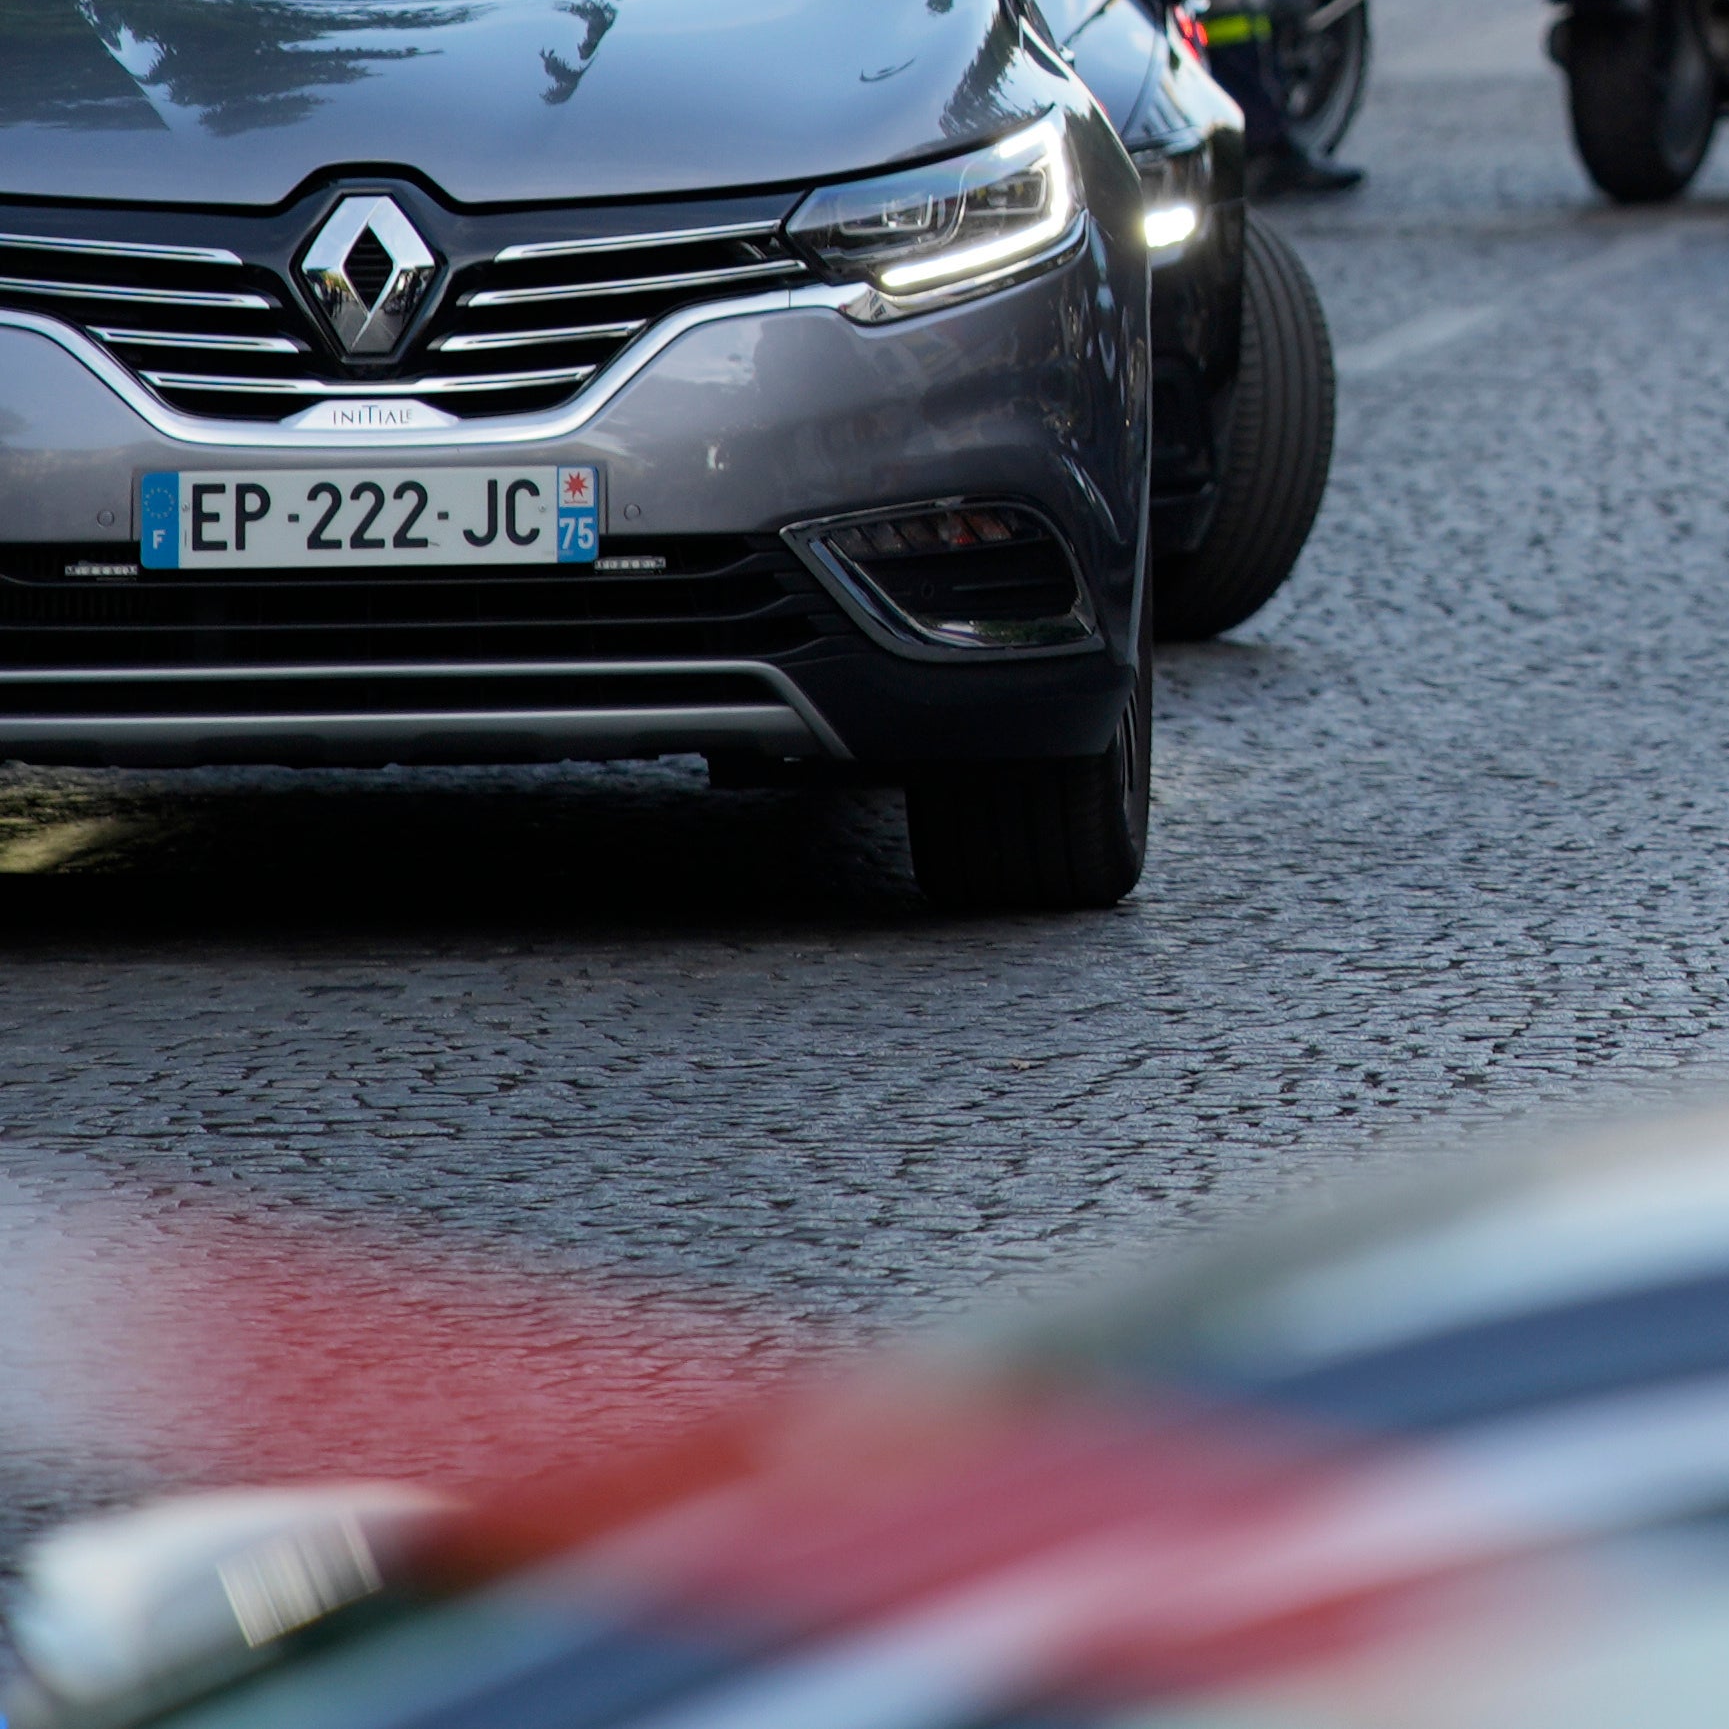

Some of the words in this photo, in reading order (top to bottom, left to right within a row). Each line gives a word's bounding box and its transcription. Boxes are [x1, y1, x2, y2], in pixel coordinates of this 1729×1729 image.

[332, 403, 414, 426] INITIALE
[151, 529, 166, 550] F
[191, 478, 542, 552] EP-222-JC
[558, 516, 597, 550] 75
